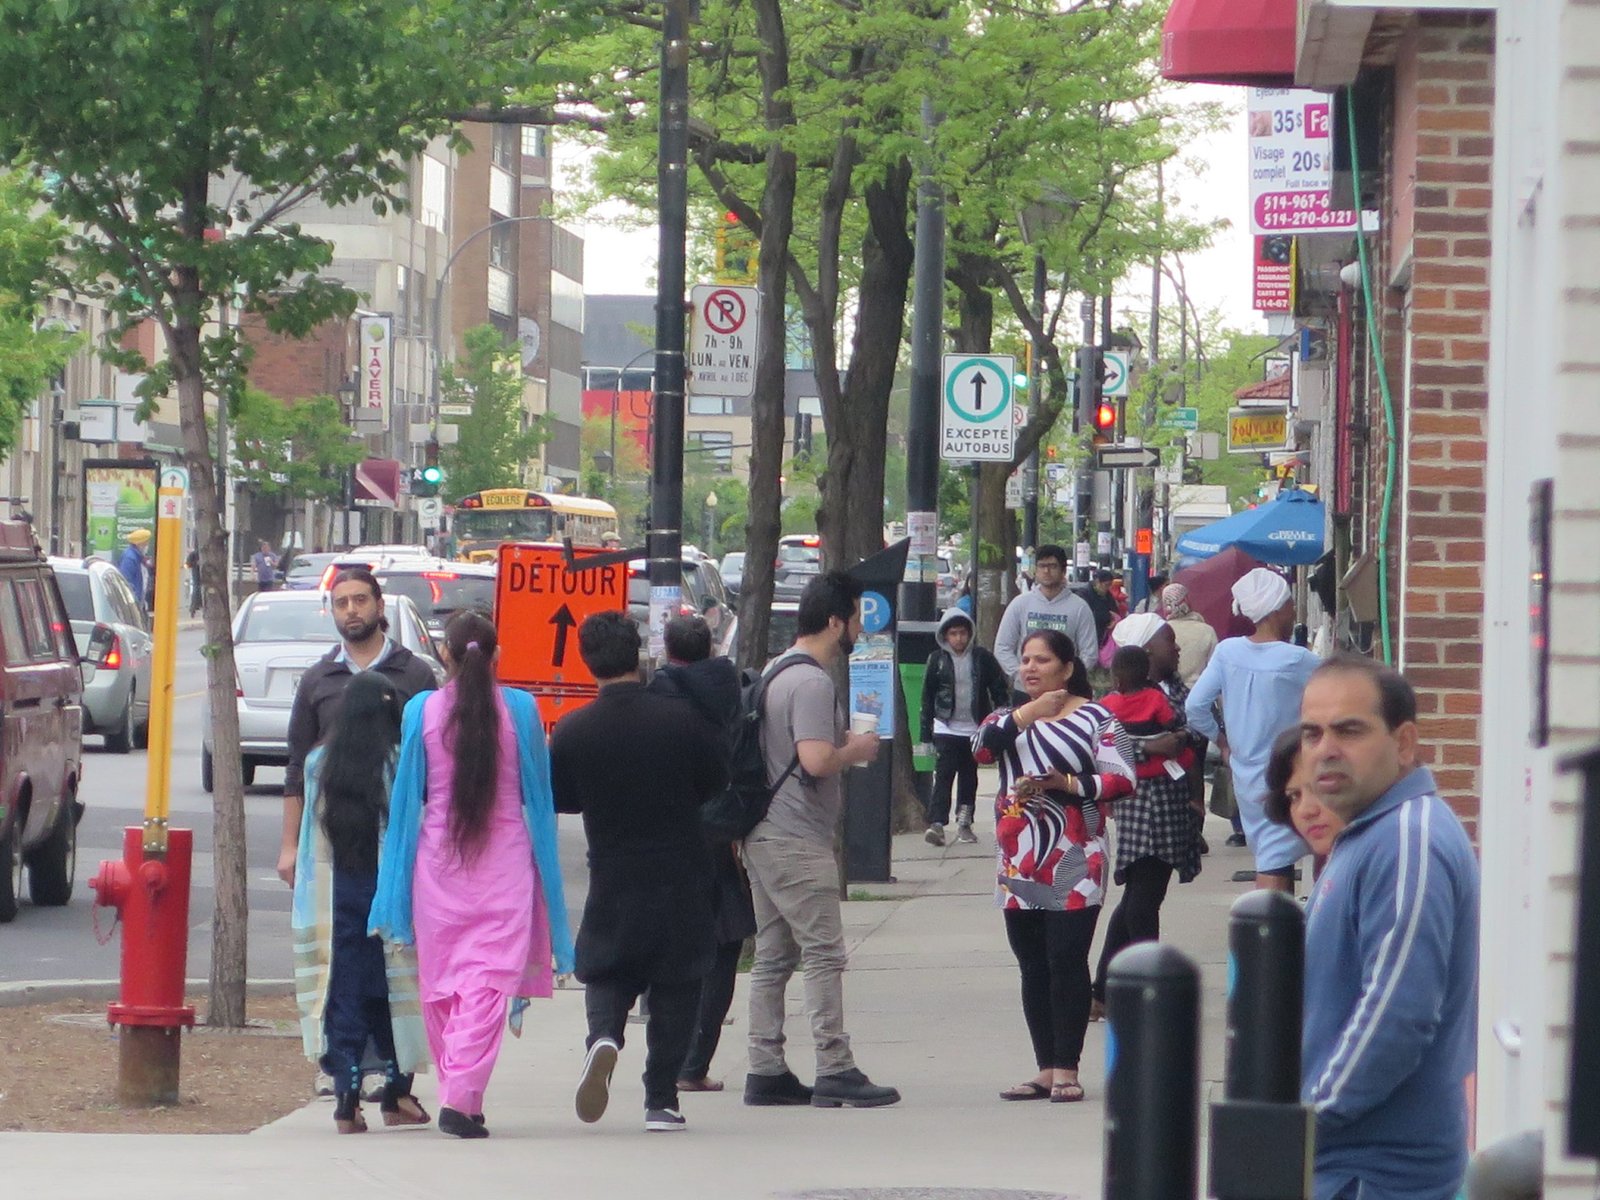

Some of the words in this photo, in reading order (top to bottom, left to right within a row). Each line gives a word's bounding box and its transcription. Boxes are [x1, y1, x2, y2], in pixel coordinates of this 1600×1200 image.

[1253, 147, 1285, 162] Visage
[1253, 166, 1286, 181] complet
[1302, 179, 1318, 187] face
[1264, 210, 1352, 226] 514-270-6121
[705, 335, 717, 348] 7h
[729, 336, 743, 349] 9h
[691, 352, 716, 367] LUN.
[729, 355, 752, 369] VEN.
[945, 442, 1010, 454] AUTOBUS
[509, 557, 616, 596] DÉTOUR
